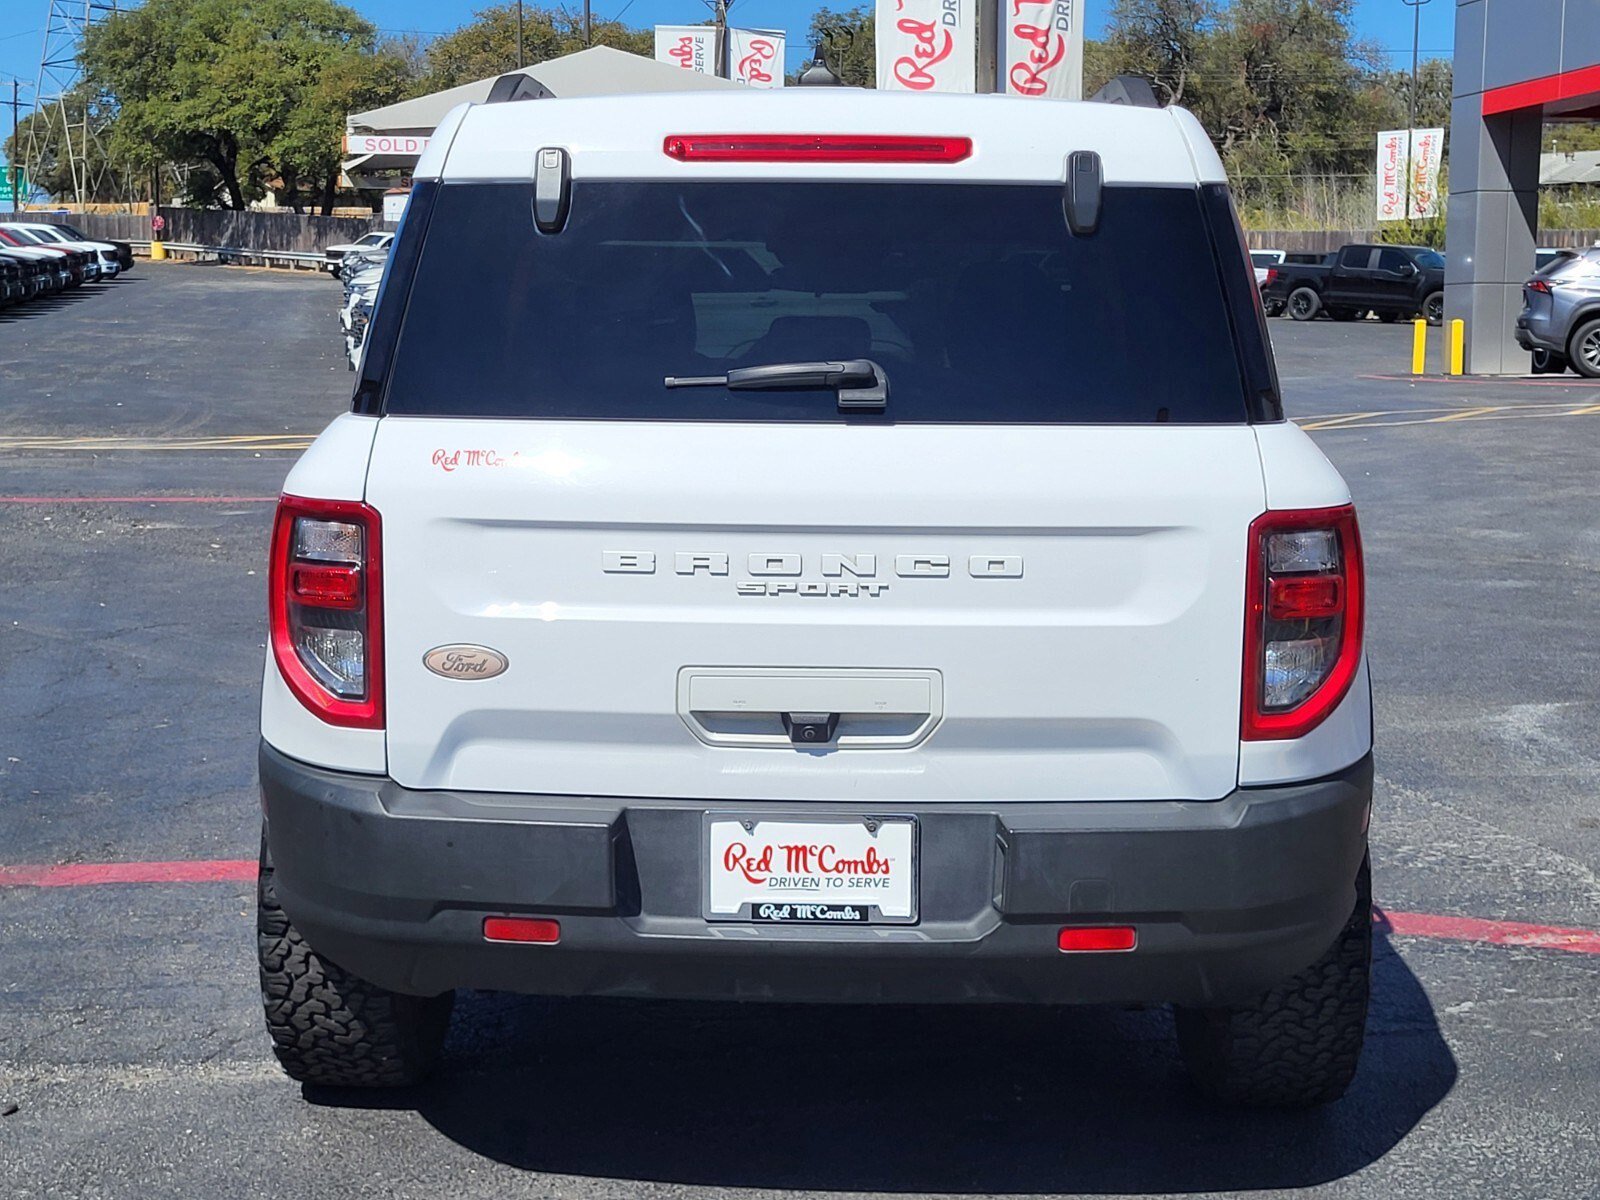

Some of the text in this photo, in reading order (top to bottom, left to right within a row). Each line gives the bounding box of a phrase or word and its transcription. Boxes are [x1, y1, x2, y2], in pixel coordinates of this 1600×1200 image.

[695, 36, 705, 74] SERVE
[738, 39, 775, 83] Red
[894, 18, 953, 90] Red
[1010, 23, 1065, 96] Red
[365, 138, 418, 152] SOLD
[432, 448, 460, 472] Red
[602, 549, 1024, 579] BRONCO
[736, 580, 890, 598] SPORT
[441, 652, 489, 673] Ford
[723, 842, 890, 884] Red McCombs
[768, 876, 891, 889] DRIVEN TO SERVE
[759, 903, 861, 920] Red McCombs
